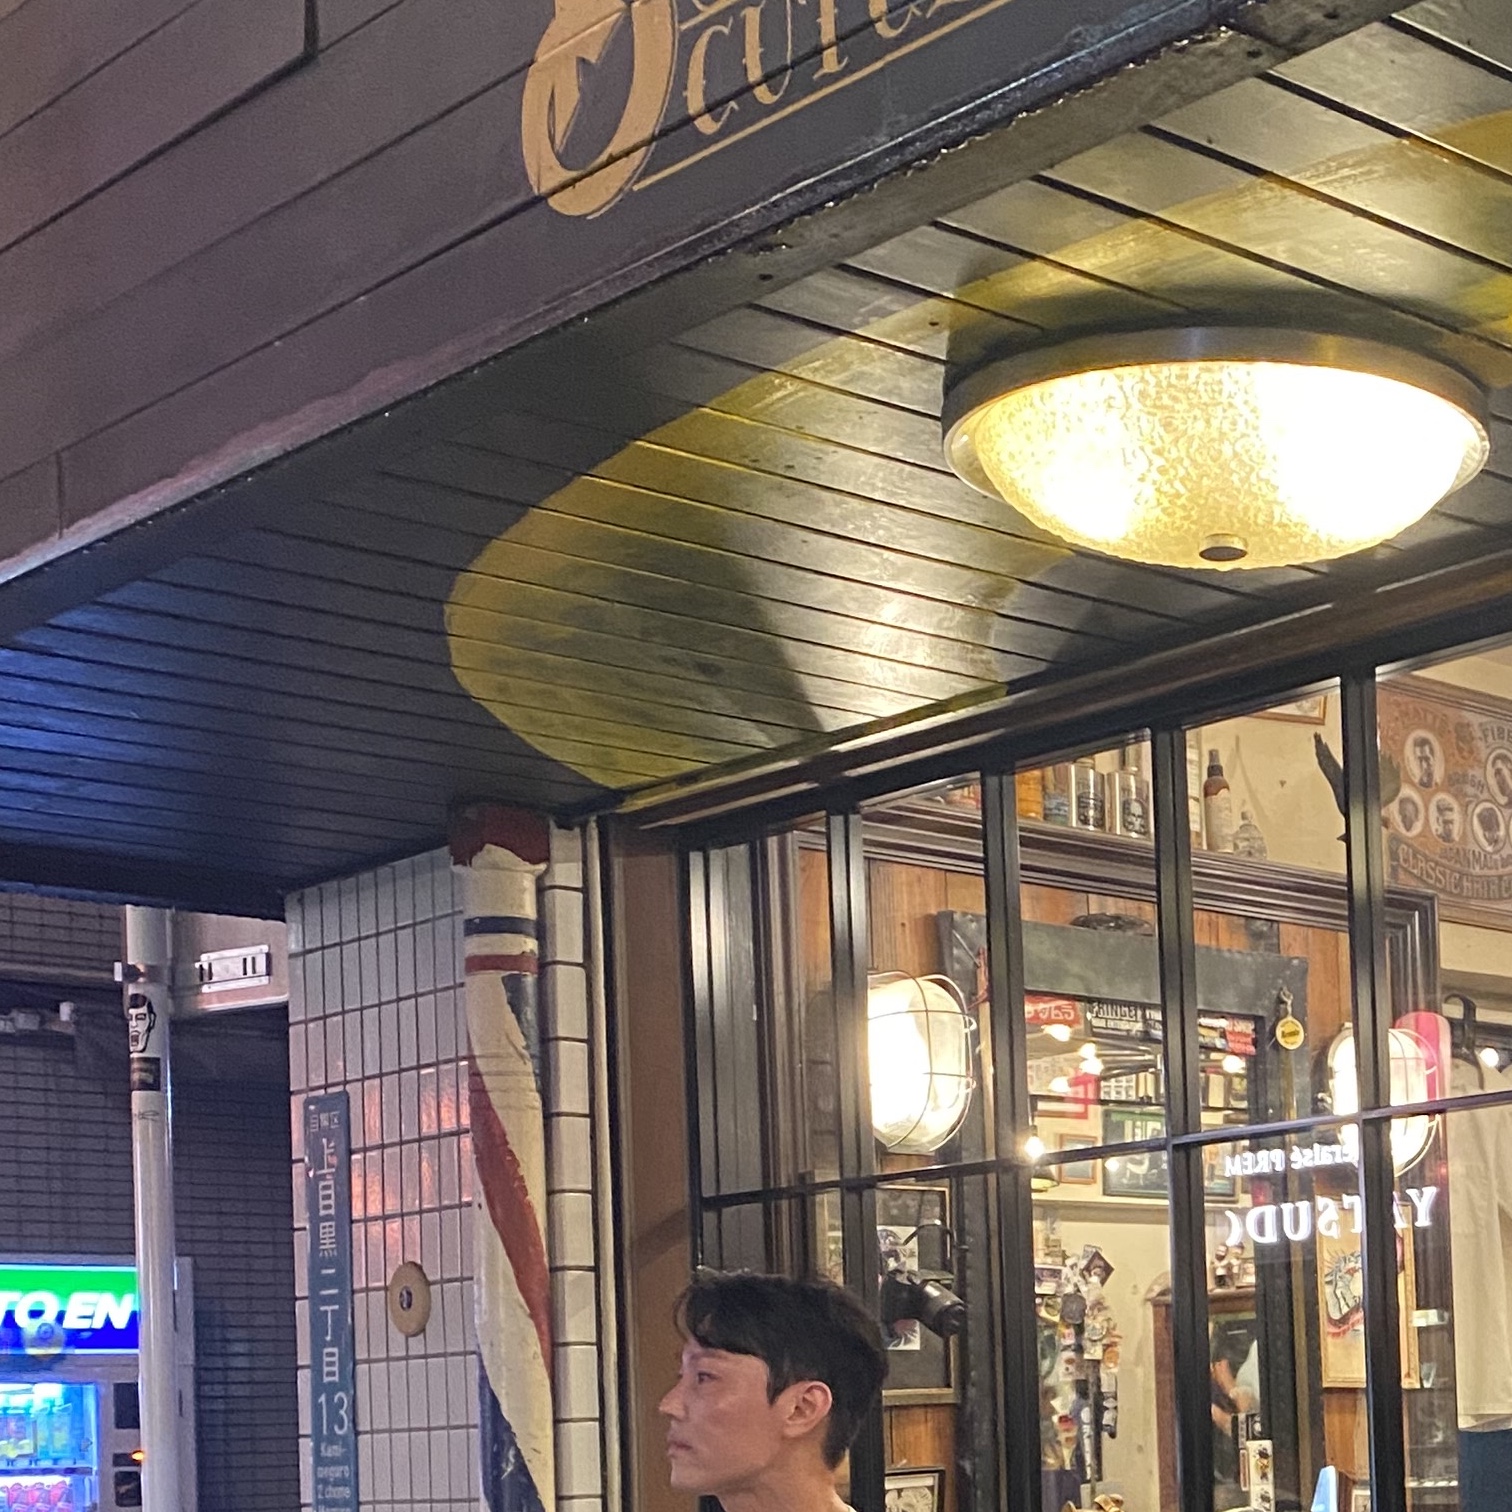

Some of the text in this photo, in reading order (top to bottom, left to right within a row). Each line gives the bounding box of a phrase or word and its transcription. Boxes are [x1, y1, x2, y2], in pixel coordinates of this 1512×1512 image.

[1399, 845, 1460, 894] CLASSIC
[62, 1291, 135, 1329] EN
[318, 1391, 349, 1435] 13
